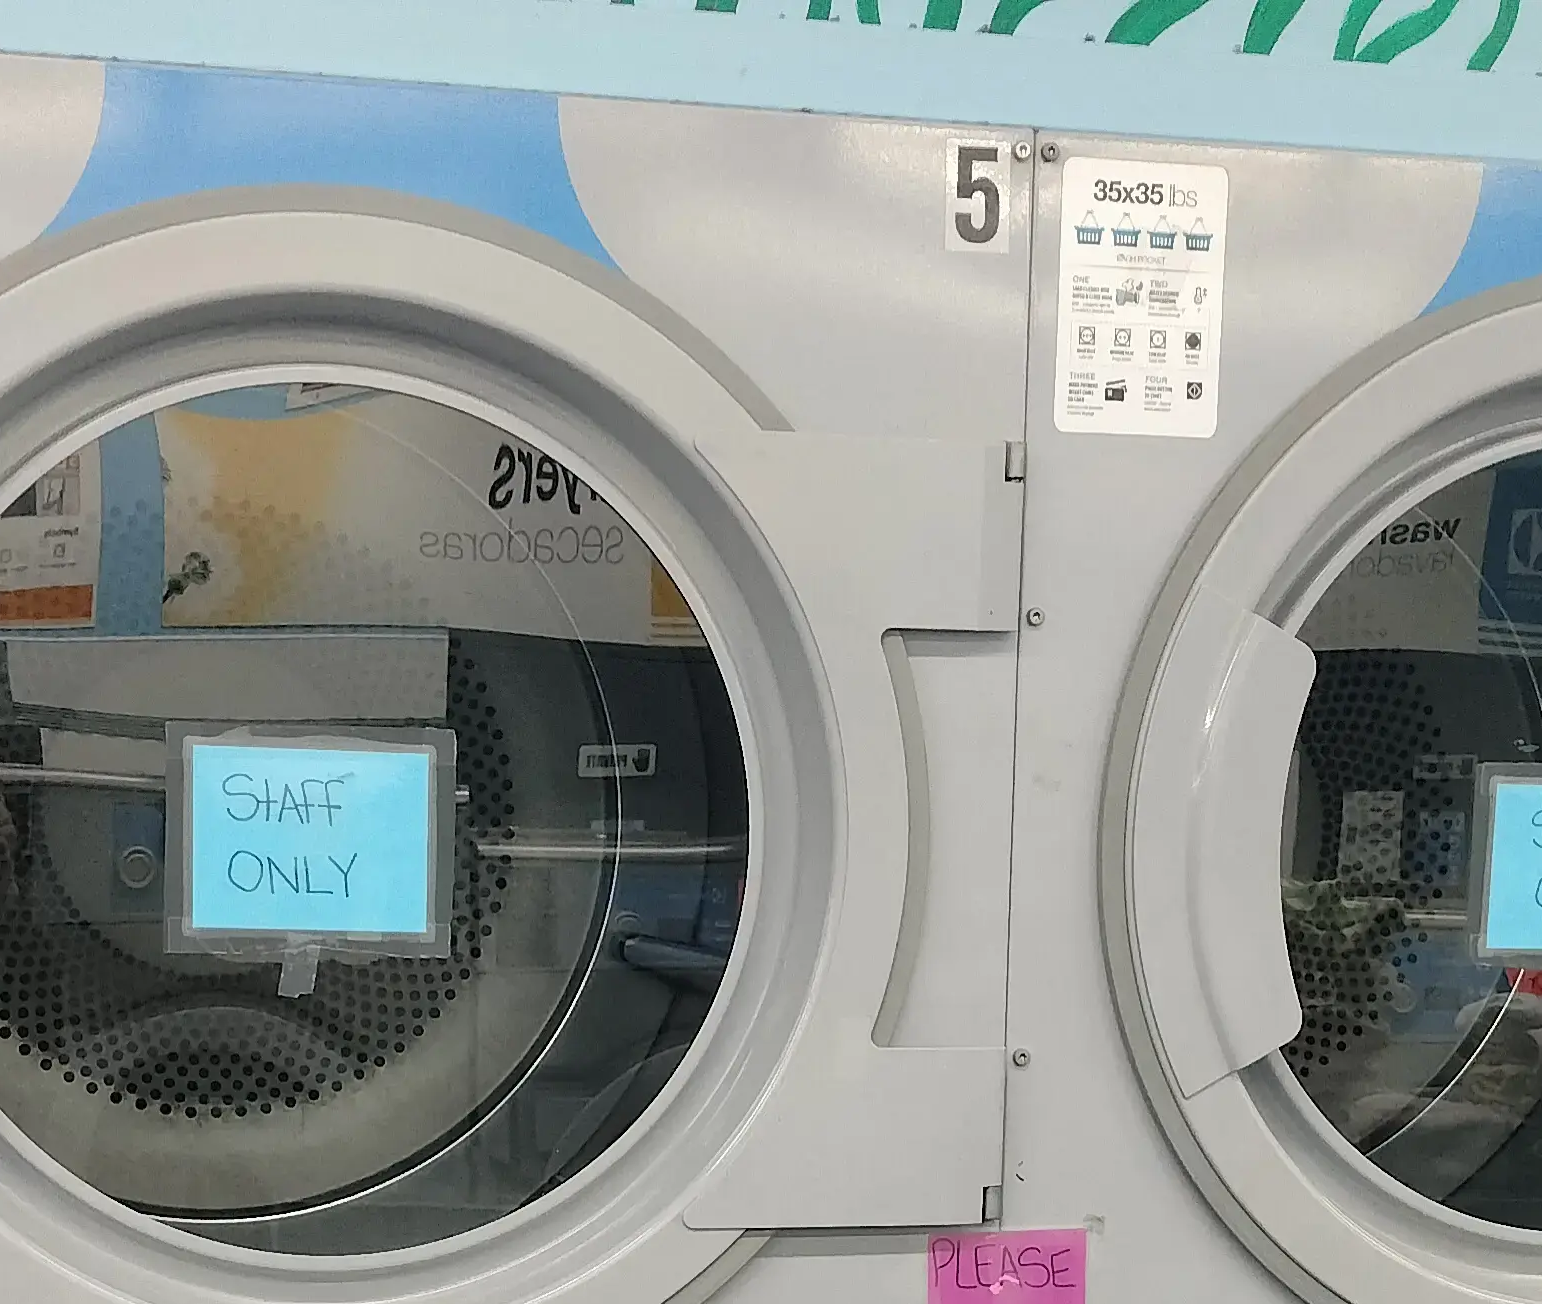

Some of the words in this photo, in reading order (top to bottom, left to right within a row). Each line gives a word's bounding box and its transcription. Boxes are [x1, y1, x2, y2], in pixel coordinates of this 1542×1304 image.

[955, 145, 1000, 243] 5
[1093, 179, 1163, 205] 35x35
[1169, 184, 1198, 208] lbs
[1146, 375, 1167, 384] FOUR
[228, 850, 357, 898] ONLY
[932, 1237, 1077, 1289] PLEASE
